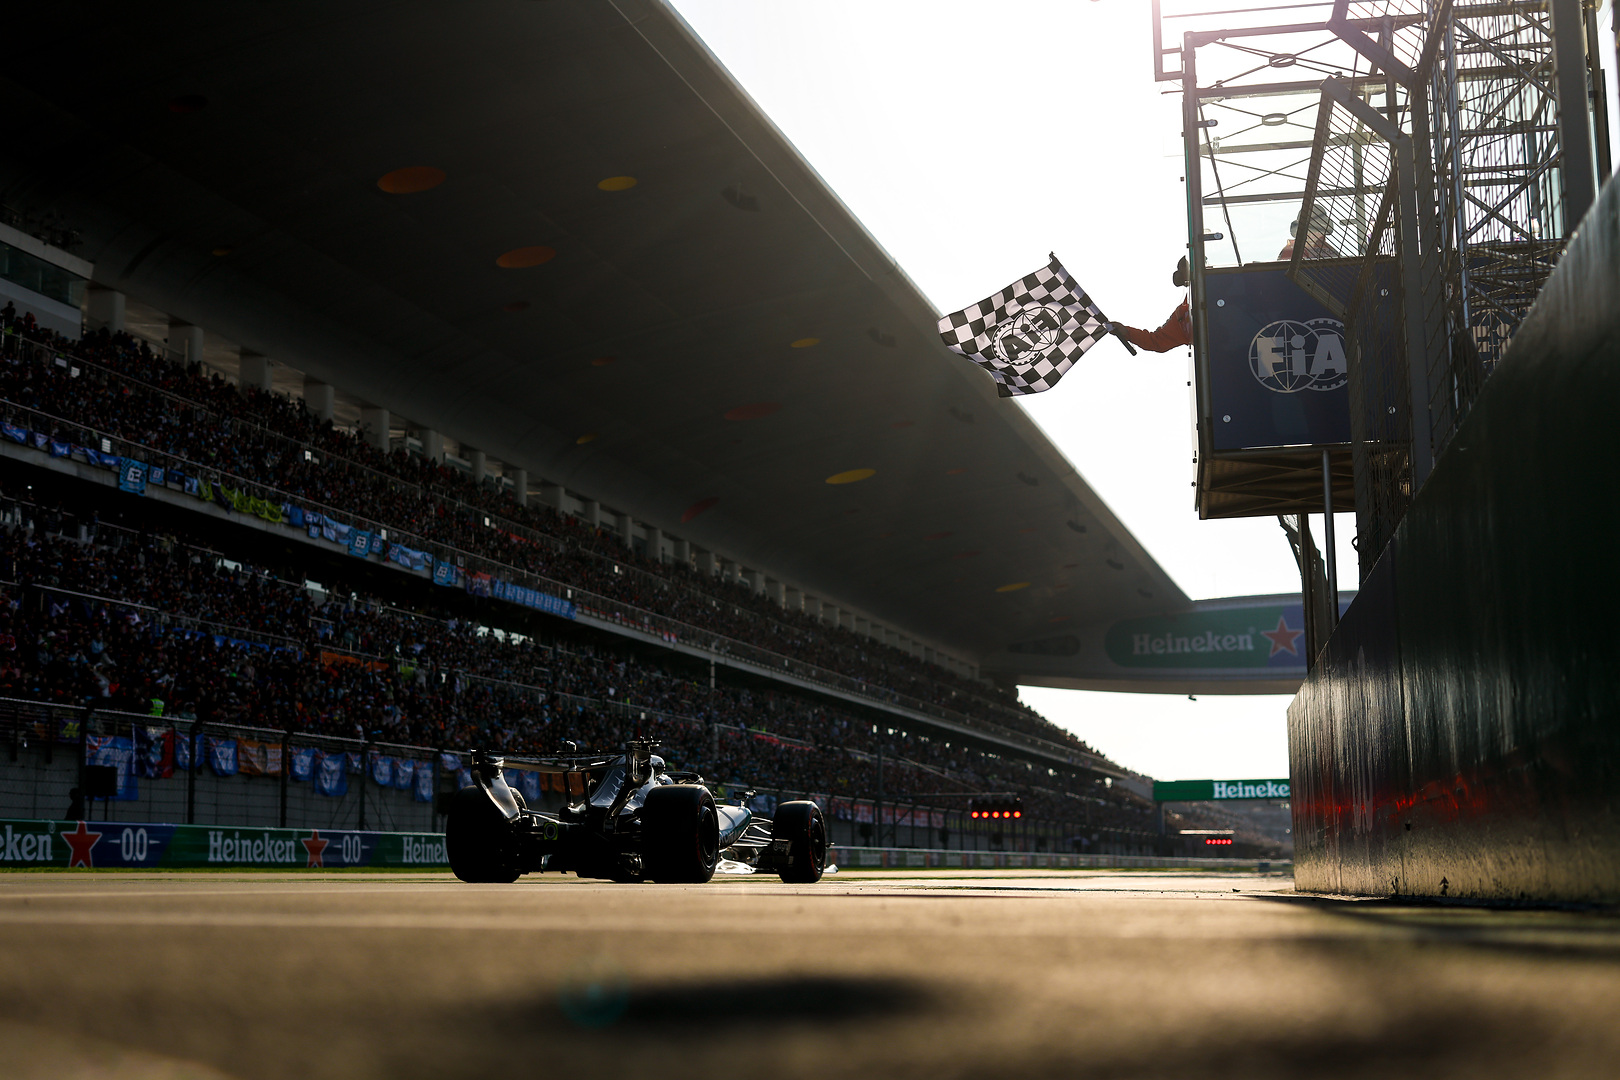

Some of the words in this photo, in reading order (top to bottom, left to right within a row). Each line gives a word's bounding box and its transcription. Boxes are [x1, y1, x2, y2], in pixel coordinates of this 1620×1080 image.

[1132, 631, 1254, 656] Heineken
[1213, 781, 1290, 798] Heineke
[122, 828, 148, 862] 0.0
[207, 831, 297, 863] Heineken
